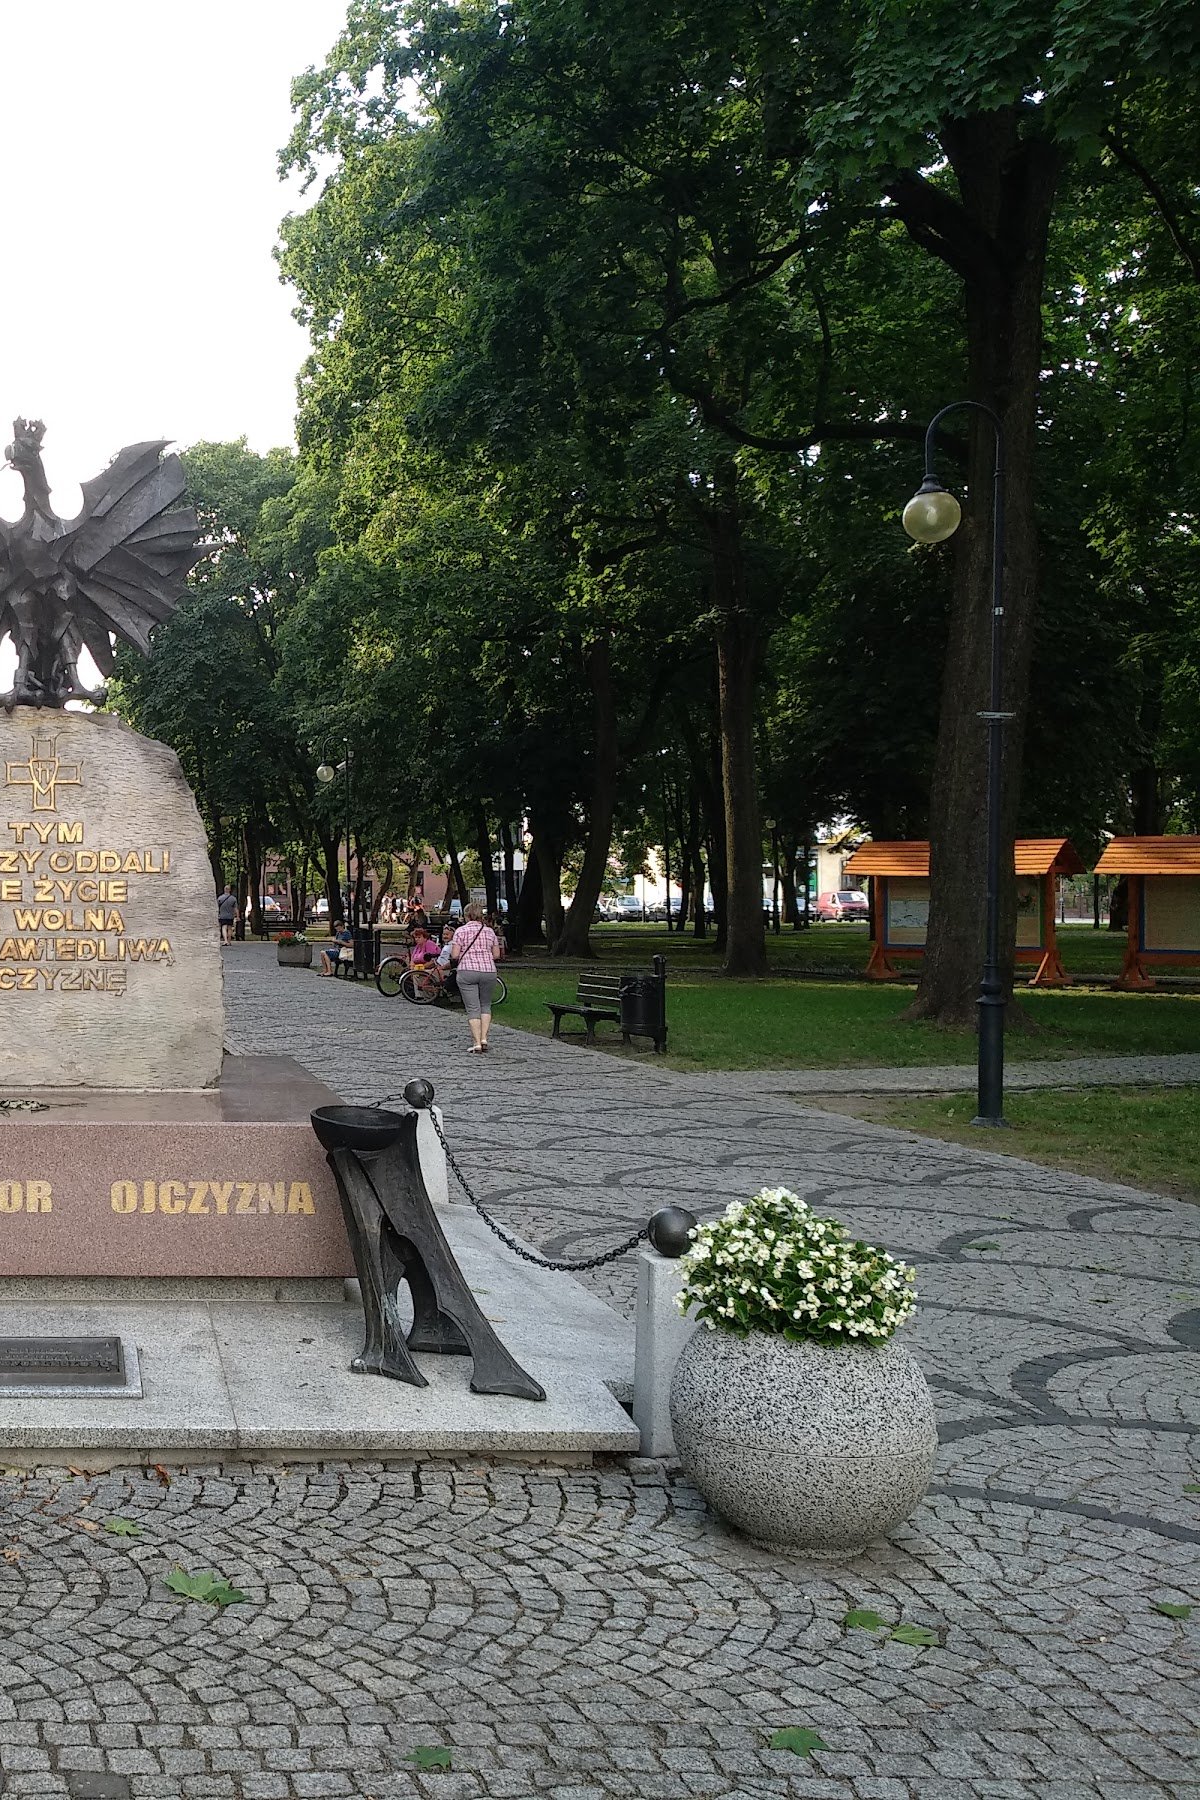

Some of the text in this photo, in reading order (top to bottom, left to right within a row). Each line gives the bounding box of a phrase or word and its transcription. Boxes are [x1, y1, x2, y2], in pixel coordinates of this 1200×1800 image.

[8, 822, 84, 844] TYM
[49, 850, 171, 874] ODDALI
[33, 874, 128, 903] ŻYCIE
[13, 908, 125, 936] WOLNĄ
[110, 1180, 317, 1215] OJCZYZNA
